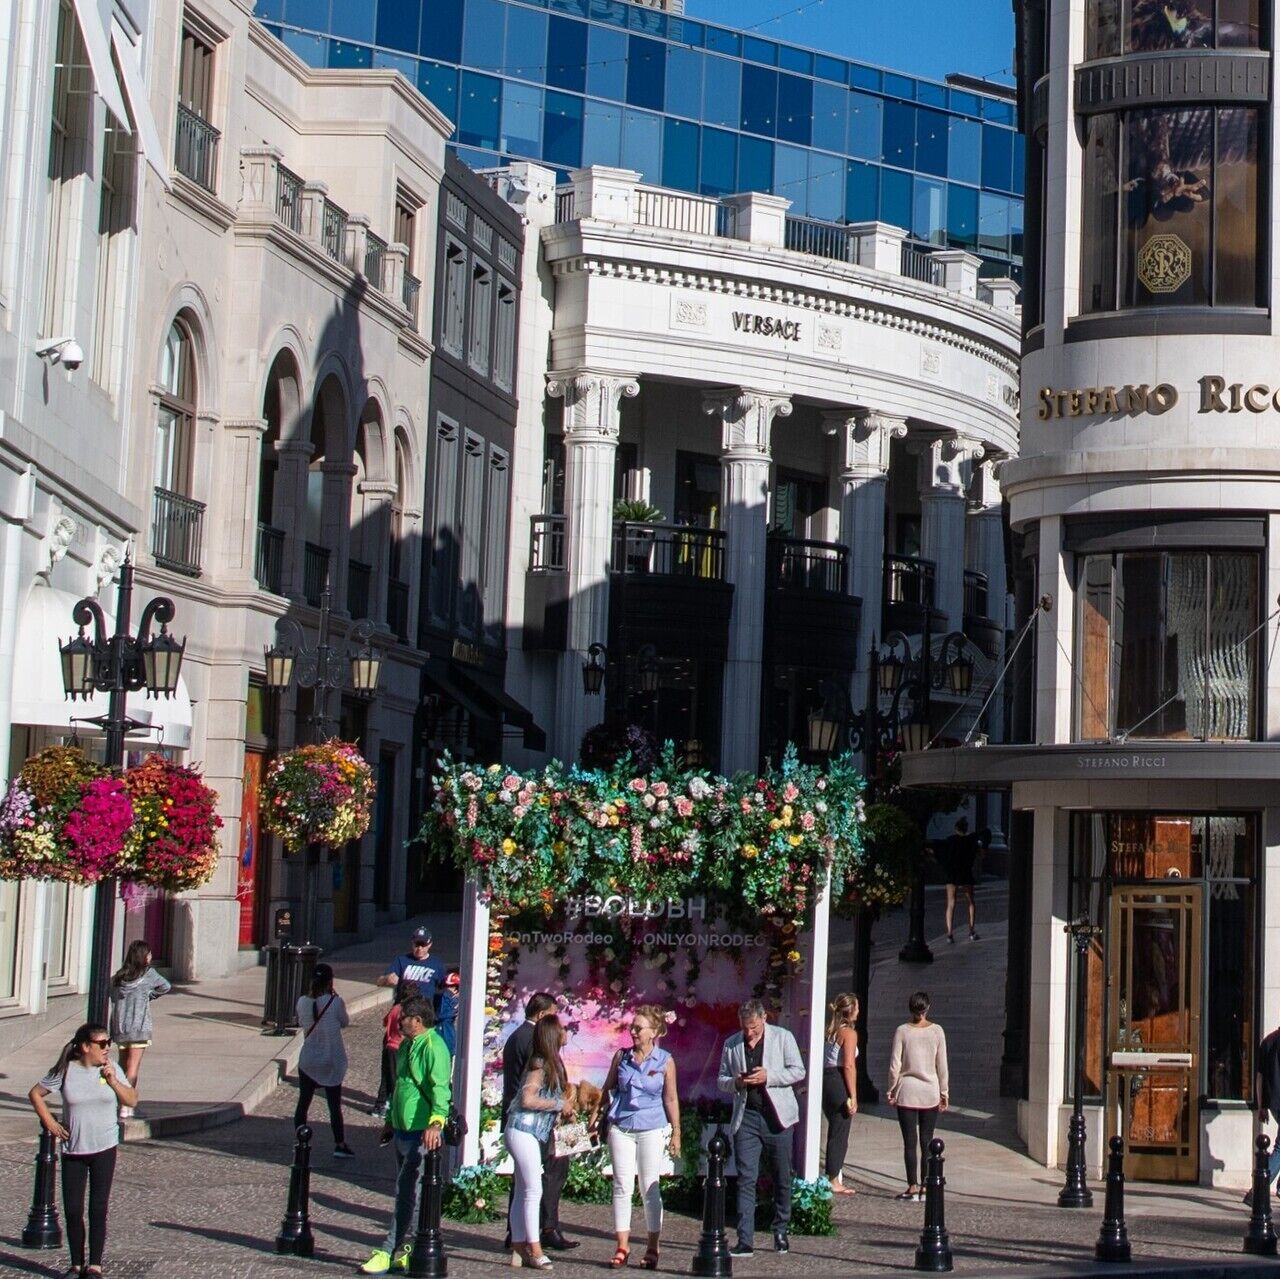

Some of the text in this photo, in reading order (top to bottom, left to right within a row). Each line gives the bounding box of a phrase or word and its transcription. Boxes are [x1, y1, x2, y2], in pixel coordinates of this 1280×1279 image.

[731, 311, 802, 342] VERSACE
[1038, 384, 1179, 420] STEFANO
[1078, 755, 1166, 768] STEFANO RICCI
[402, 964, 436, 983] NIKE
